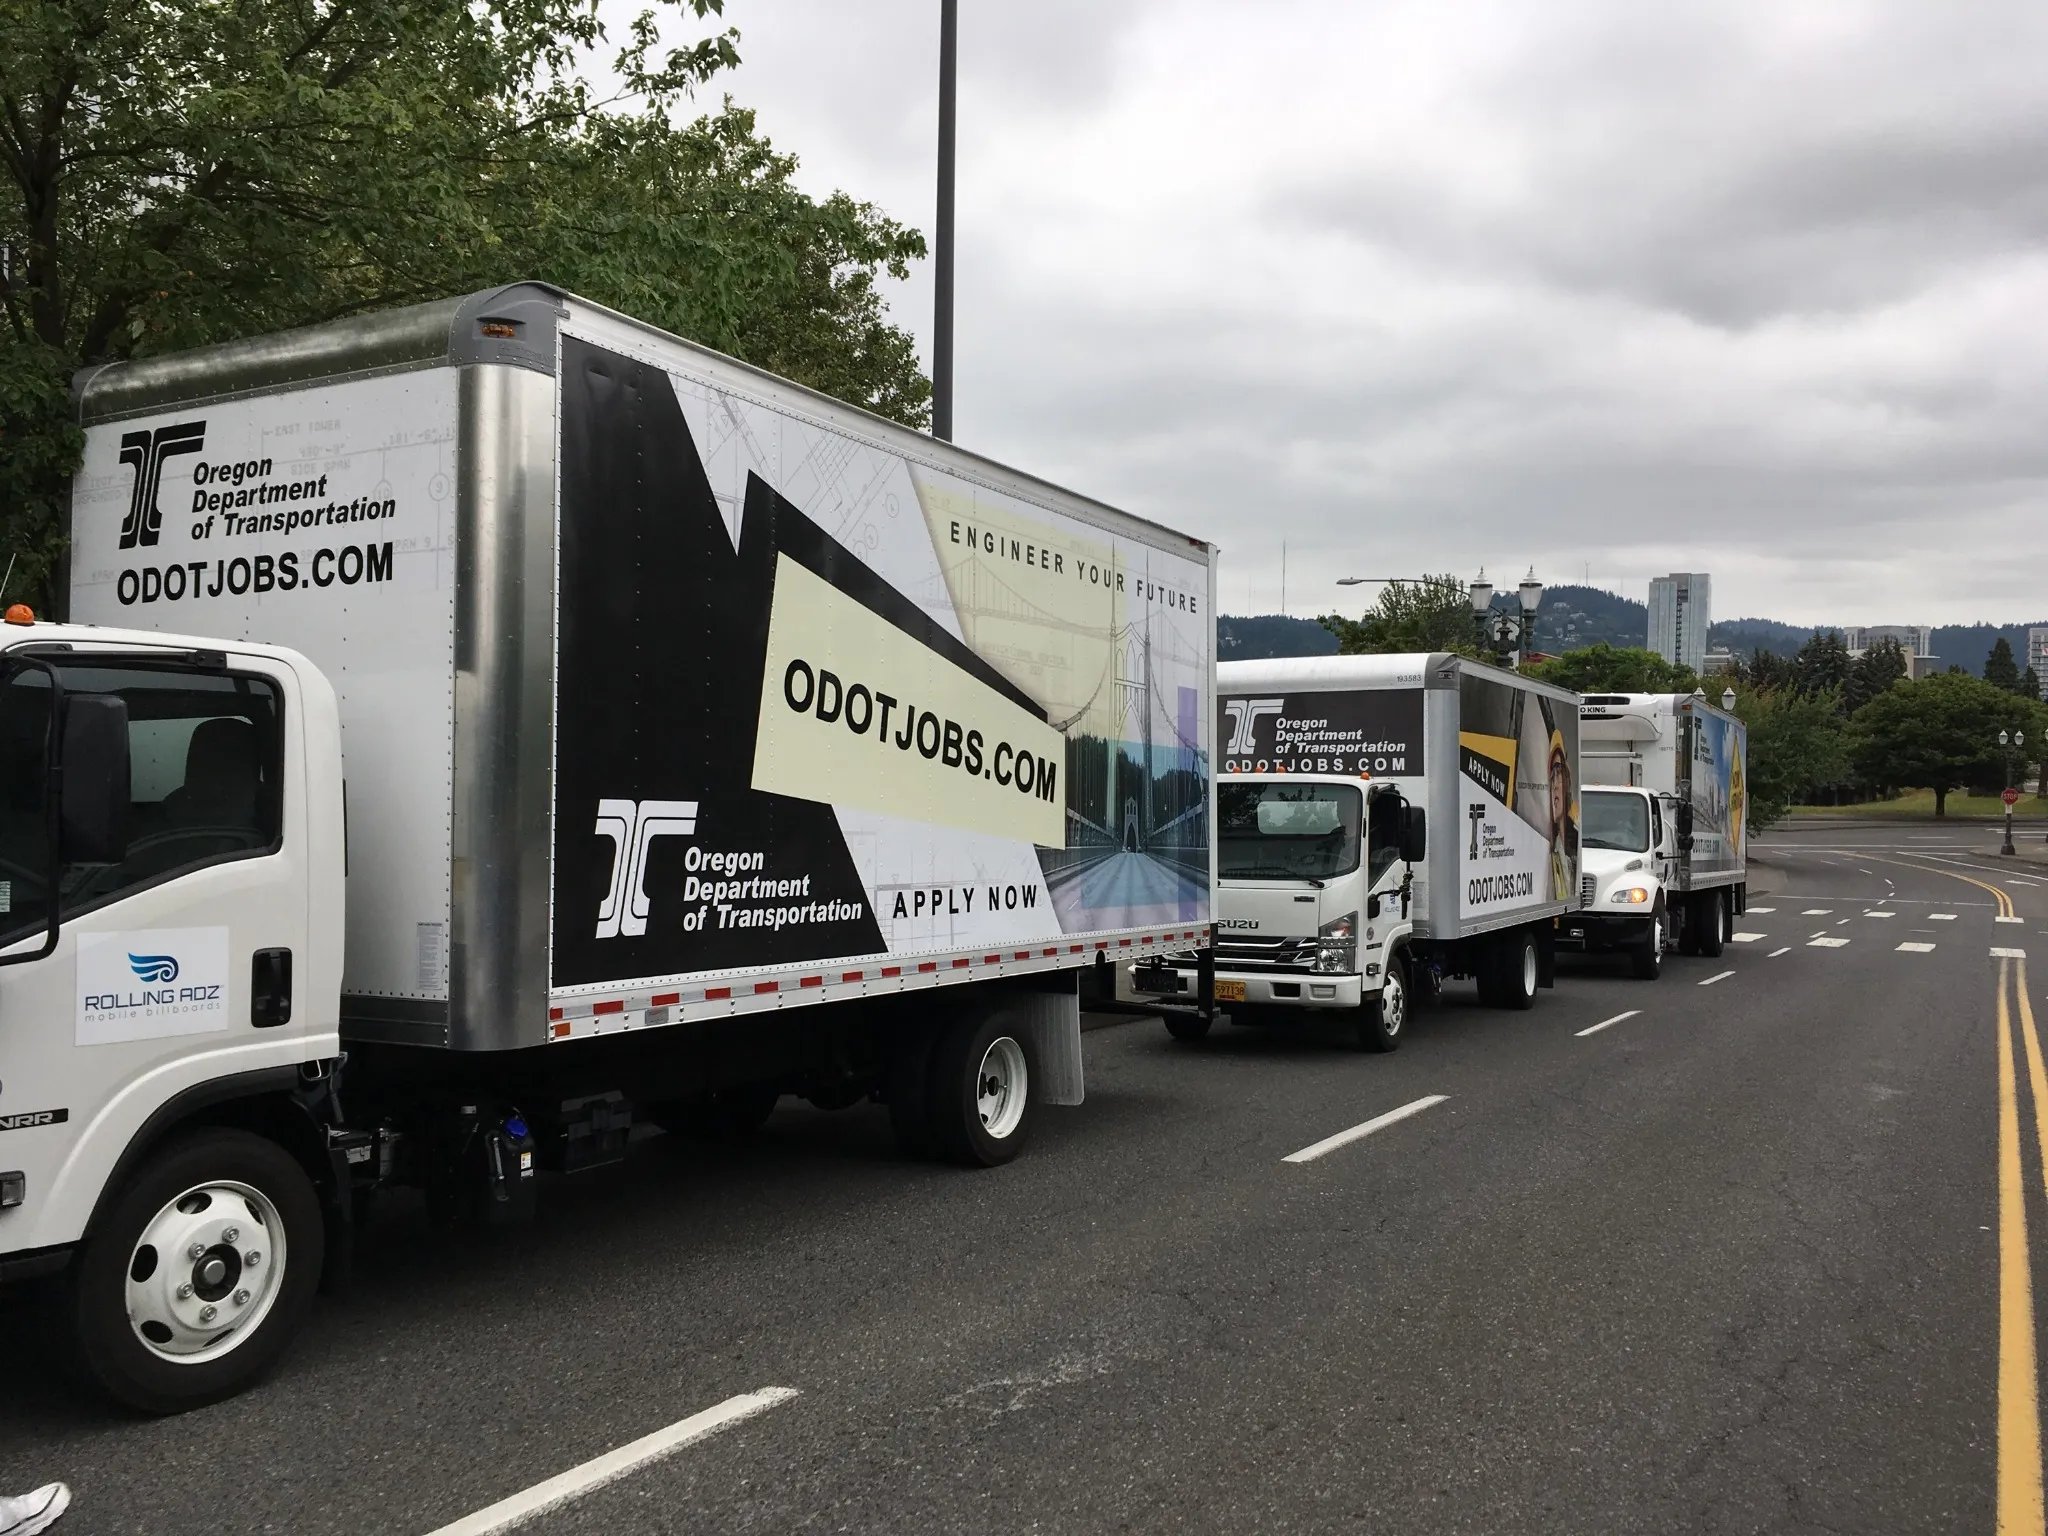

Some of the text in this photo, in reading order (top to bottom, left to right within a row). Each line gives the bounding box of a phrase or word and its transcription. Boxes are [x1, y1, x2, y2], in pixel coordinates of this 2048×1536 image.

[193, 457, 272, 487] Oregon
[192, 473, 328, 516] Department
[191, 497, 396, 542] of Transportation
[117, 541, 394, 606] ODOTJOBS.COM
[950, 521, 1064, 574] ENGINEER
[1077, 559, 1125, 592] YOUR
[1137, 580, 1197, 614] FUTURE
[783, 658, 1056, 803] ODOTJOBS.COM
[1275, 718, 1328, 730] Oregon
[1275, 728, 1362, 742] Department
[1275, 741, 1406, 755] of Transportation
[1225, 757, 1406, 773] ODOTJOBS.COM
[1468, 756, 1505, 797] APPLY NOW
[685, 846, 764, 876] Oregon
[683, 874, 811, 905] Department
[893, 884, 1038, 919] APPLY NOW
[1468, 872, 1533, 905] ODOTJOBS.COM
[683, 899, 863, 932] of Transportation
[1217, 918, 1259, 929] SUZU
[85, 984, 220, 1012] ROLLING ADZ
[85, 1001, 221, 1023] mobile billboards
